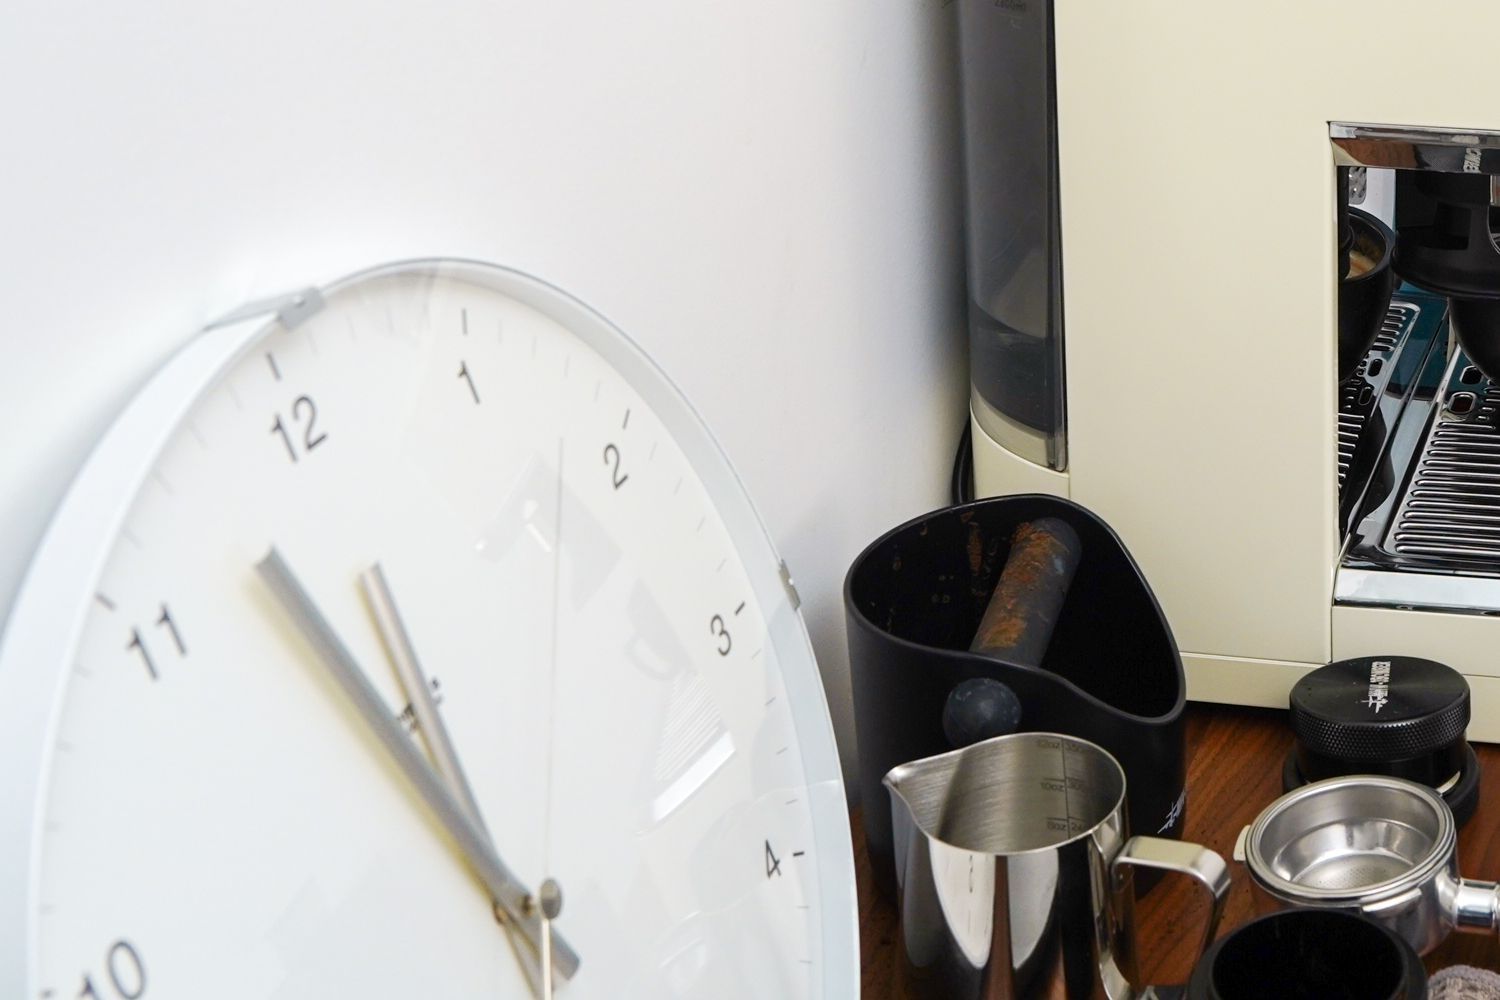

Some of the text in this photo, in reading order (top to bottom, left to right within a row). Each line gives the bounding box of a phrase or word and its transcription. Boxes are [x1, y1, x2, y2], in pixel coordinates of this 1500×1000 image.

[458, 360, 481, 404] 1
[270, 395, 328, 463] 12
[603, 443, 629, 490] 2
[125, 602, 188, 681] 11
[710, 614, 732, 657] 3
[765, 839, 781, 879] 4
